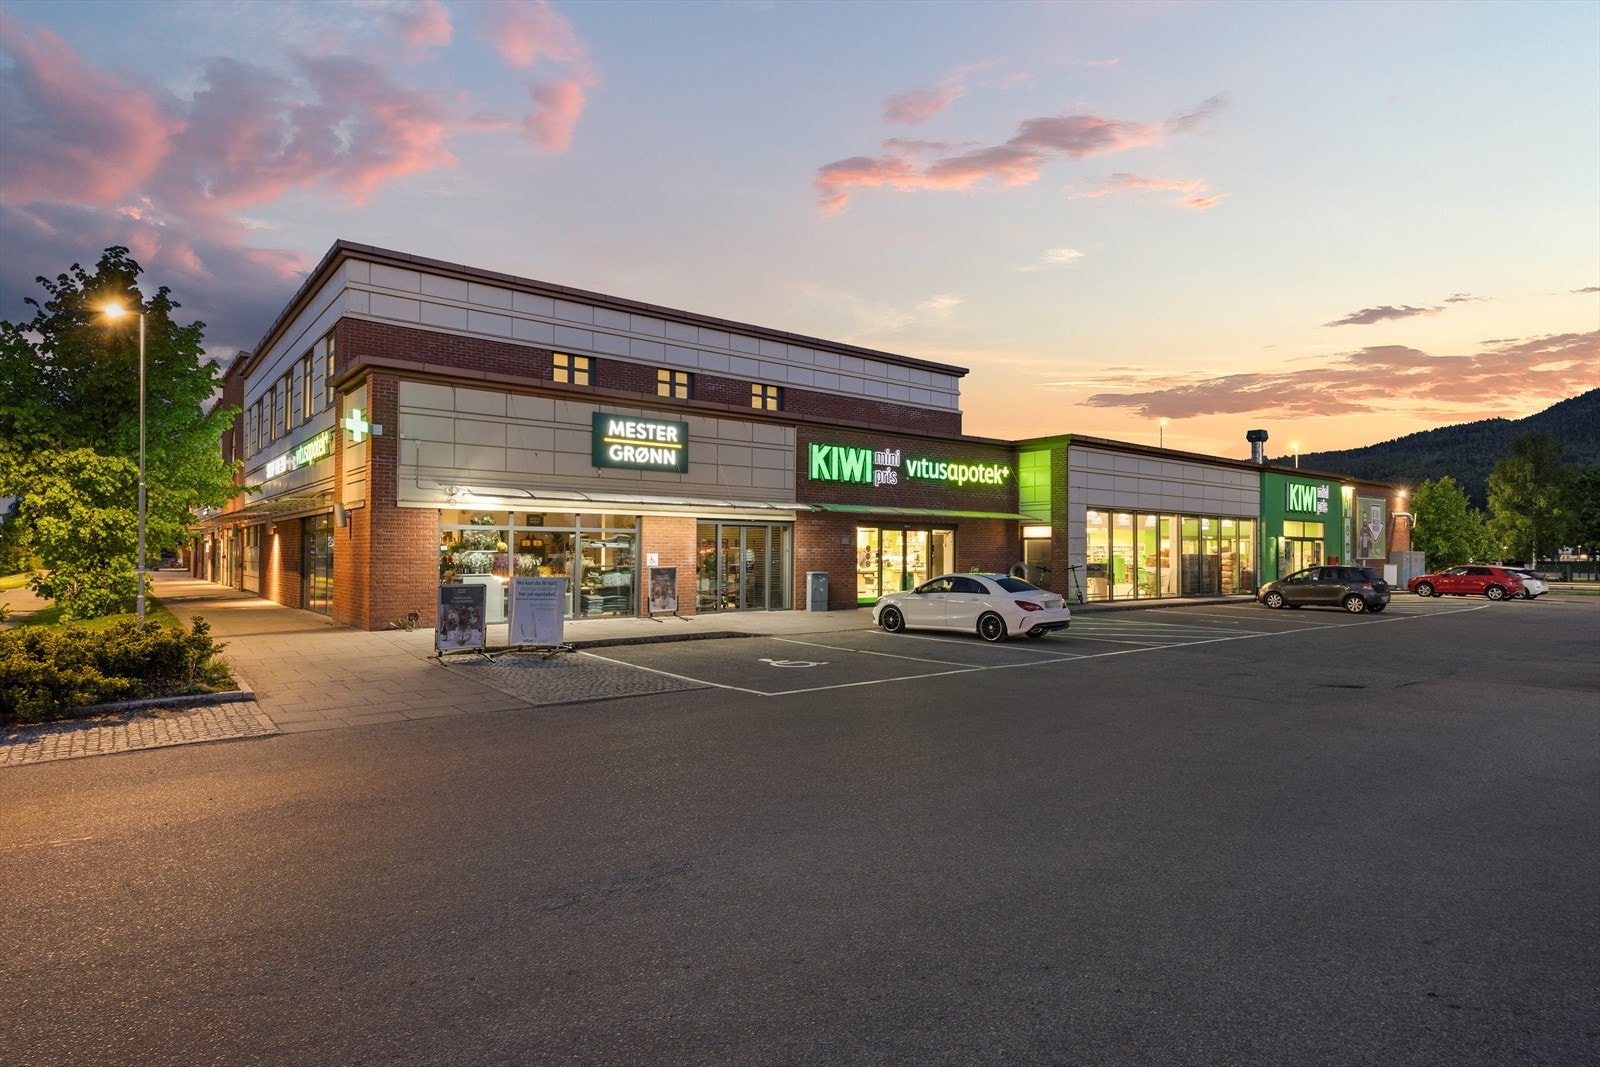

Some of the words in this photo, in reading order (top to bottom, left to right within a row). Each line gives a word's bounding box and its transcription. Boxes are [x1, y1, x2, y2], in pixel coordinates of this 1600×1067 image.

[608, 420, 678, 442] MESTER
[608, 444, 676, 466] GRØNN
[810, 443, 872, 483] KIWI
[874, 449, 900, 467] mini
[874, 467, 898, 487] pris
[1289, 483, 1317, 512] KIWI
